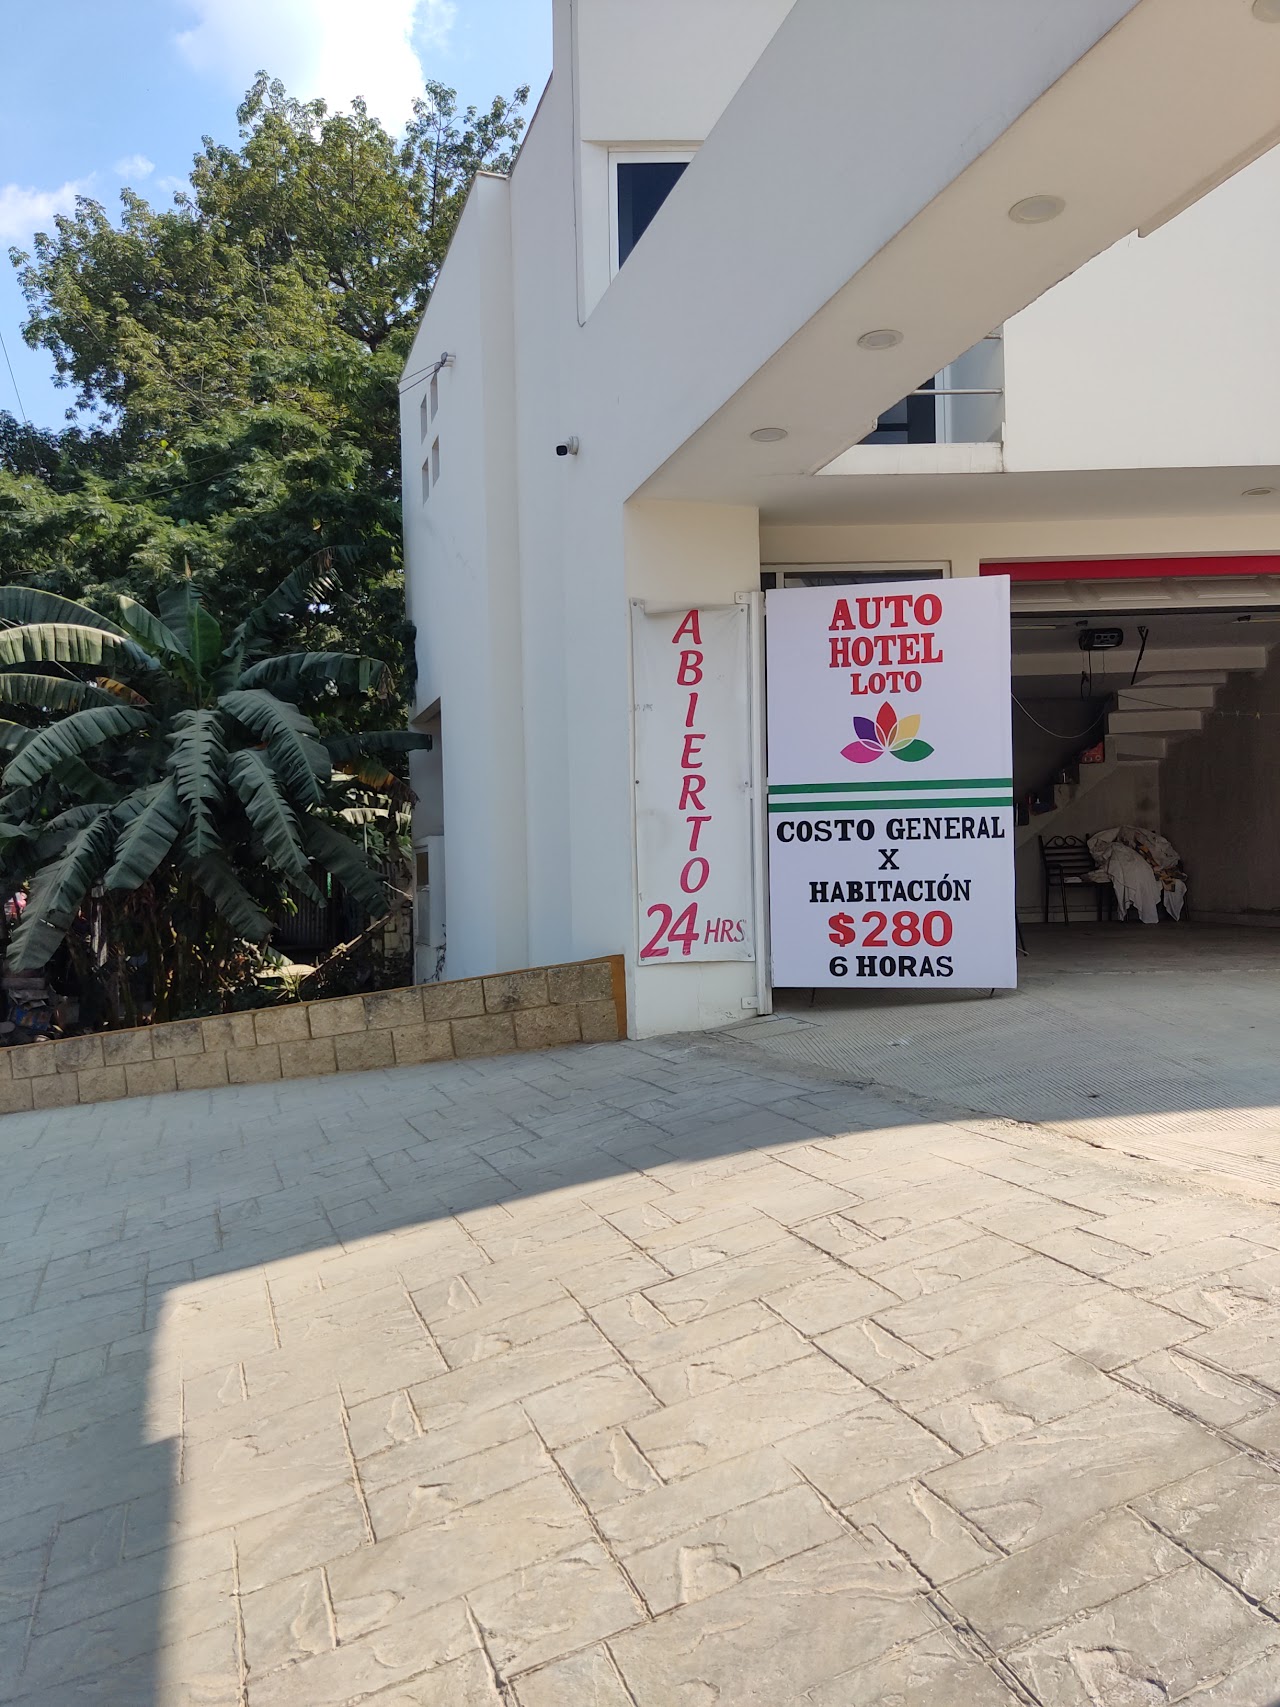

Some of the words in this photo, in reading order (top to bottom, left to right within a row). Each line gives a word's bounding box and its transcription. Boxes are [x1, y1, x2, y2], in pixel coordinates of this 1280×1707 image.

[829, 594, 942, 630] AUTO
[829, 633, 943, 668] HOTEL
[851, 671, 921, 695] LOTO
[672, 609, 712, 893] ABIERTO
[777, 819, 875, 842] COSTO
[886, 817, 1005, 840] GENERAL
[878, 849, 899, 870] X
[809, 874, 970, 902] HABITACIÓN
[640, 902, 699, 958] 24
[704, 918, 746, 944] HRS
[828, 911, 953, 947] $280
[829, 956, 848, 977] 6
[856, 956, 953, 977] HORAS
